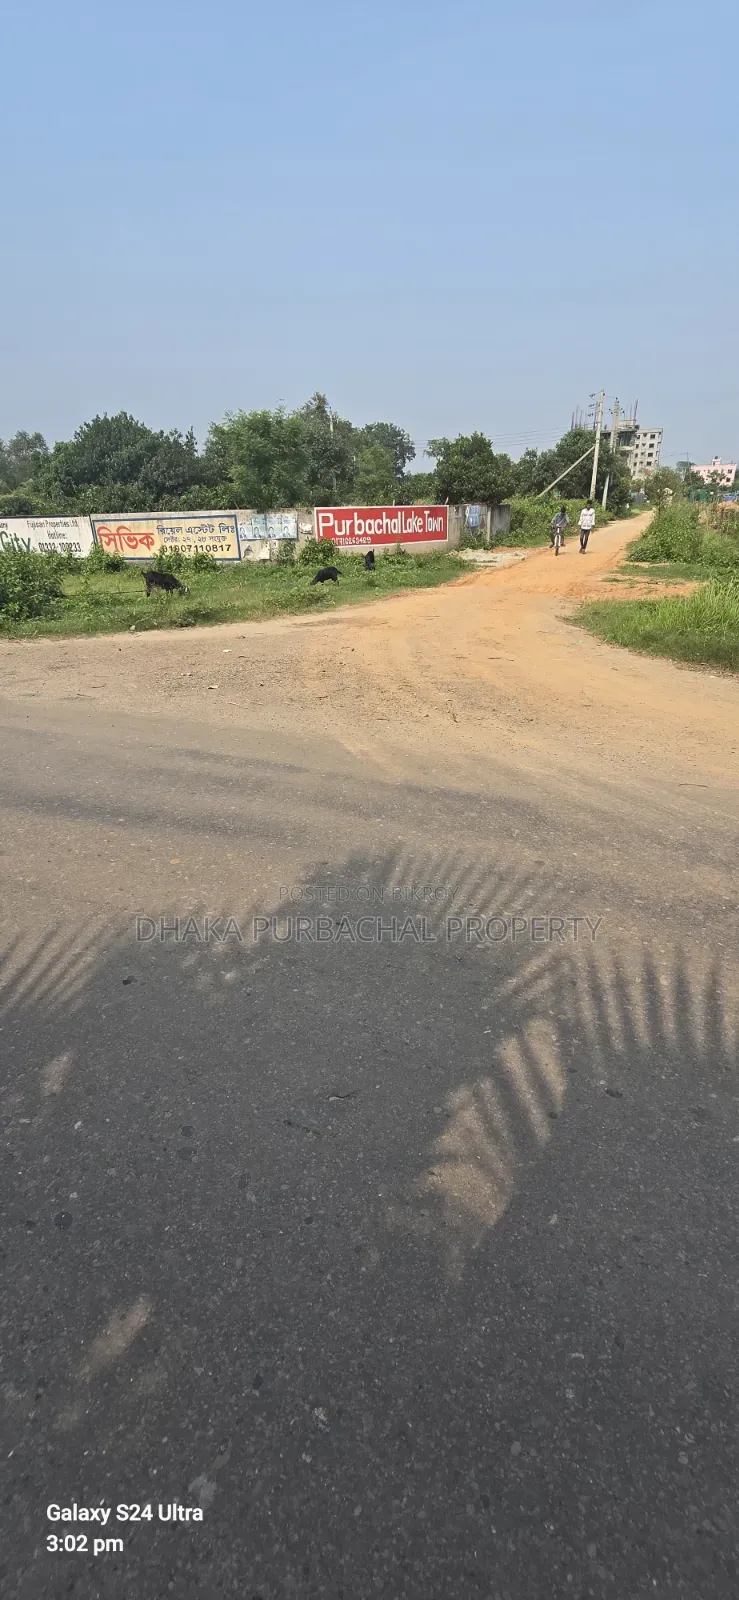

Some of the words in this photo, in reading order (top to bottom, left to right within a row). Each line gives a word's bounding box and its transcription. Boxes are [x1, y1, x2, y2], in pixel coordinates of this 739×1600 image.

[45, 519, 69, 530] Properties
[318, 511, 401, 537] Purbachal
[402, 510, 423, 534] Lake
[424, 510, 443, 533] Town
[97, 525, 155, 552] সিভিক
